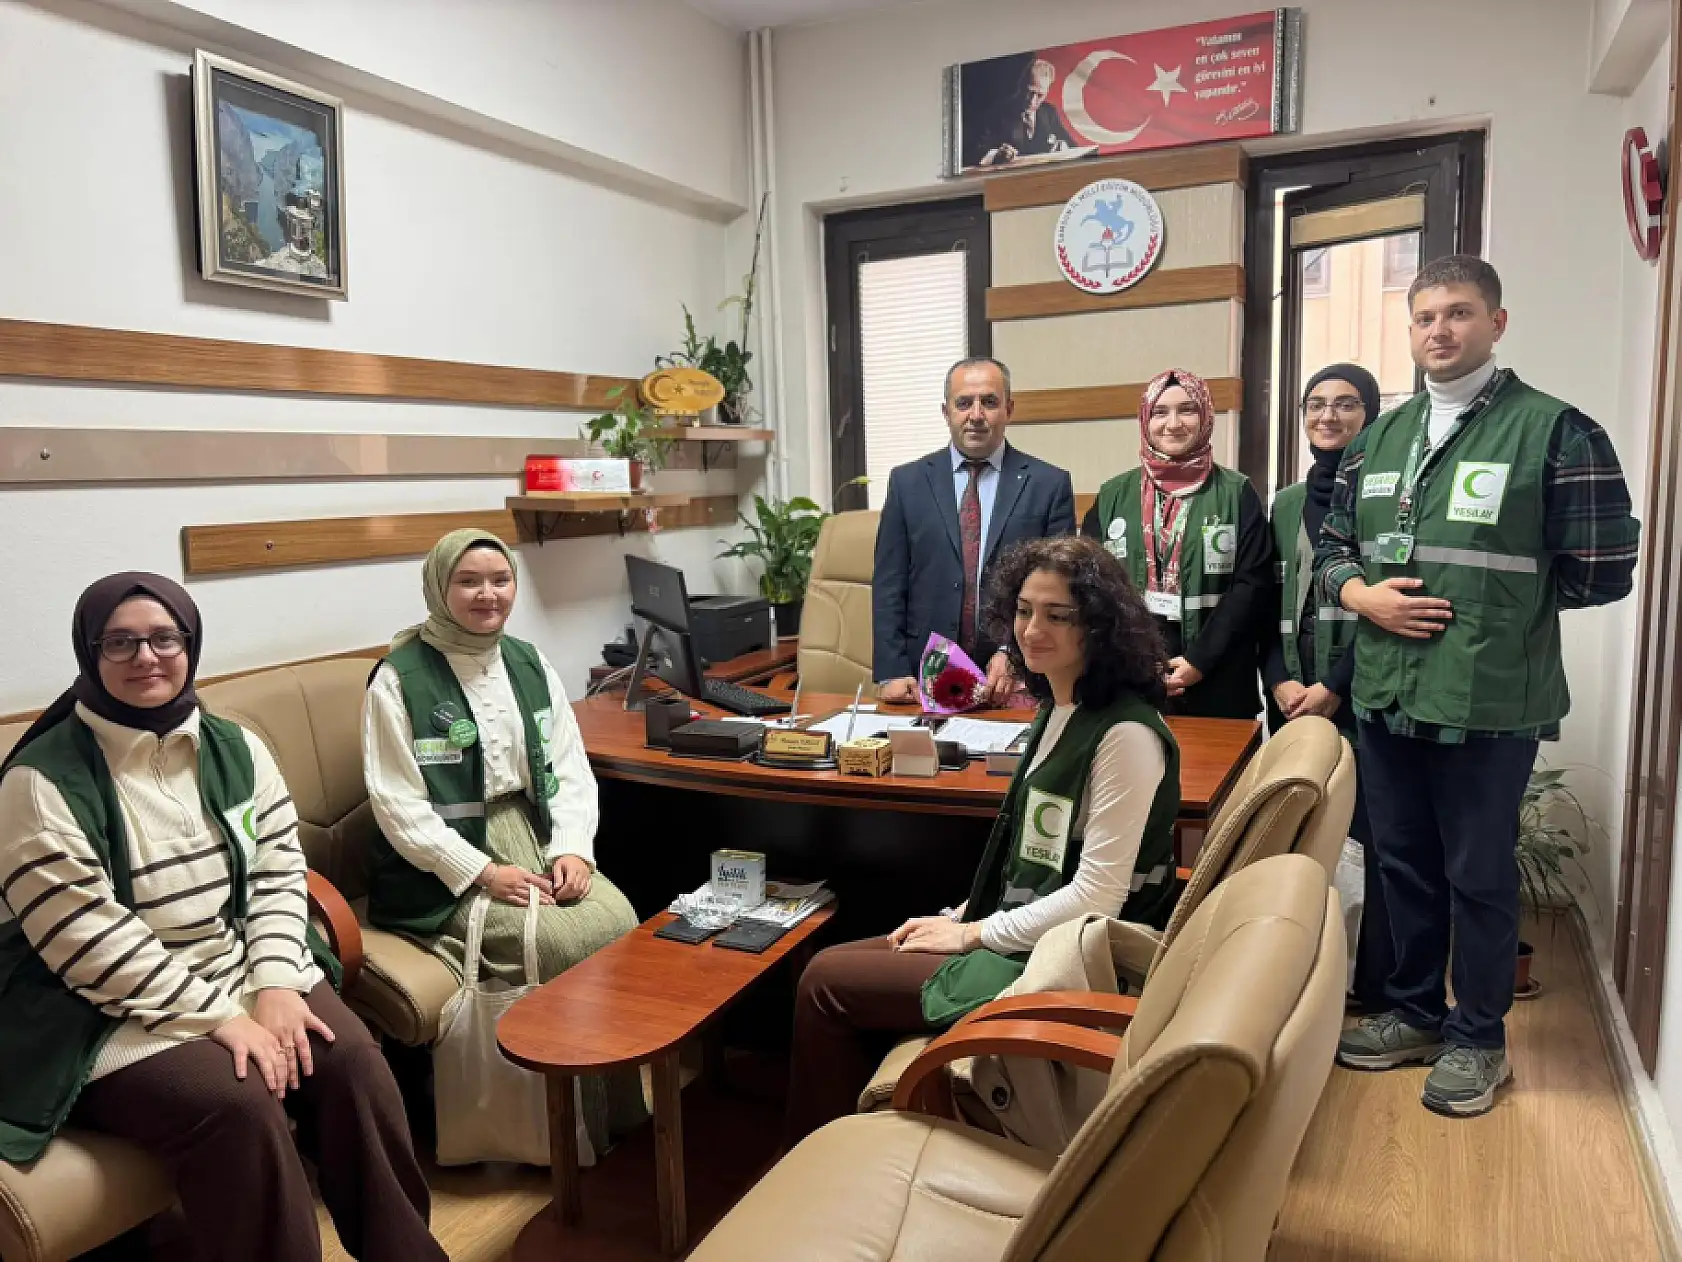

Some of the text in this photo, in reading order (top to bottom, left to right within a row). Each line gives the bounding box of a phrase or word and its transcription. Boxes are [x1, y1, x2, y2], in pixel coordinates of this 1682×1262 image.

[1195, 47, 1259, 65] en çok seven
[1238, 65, 1250, 75] en
